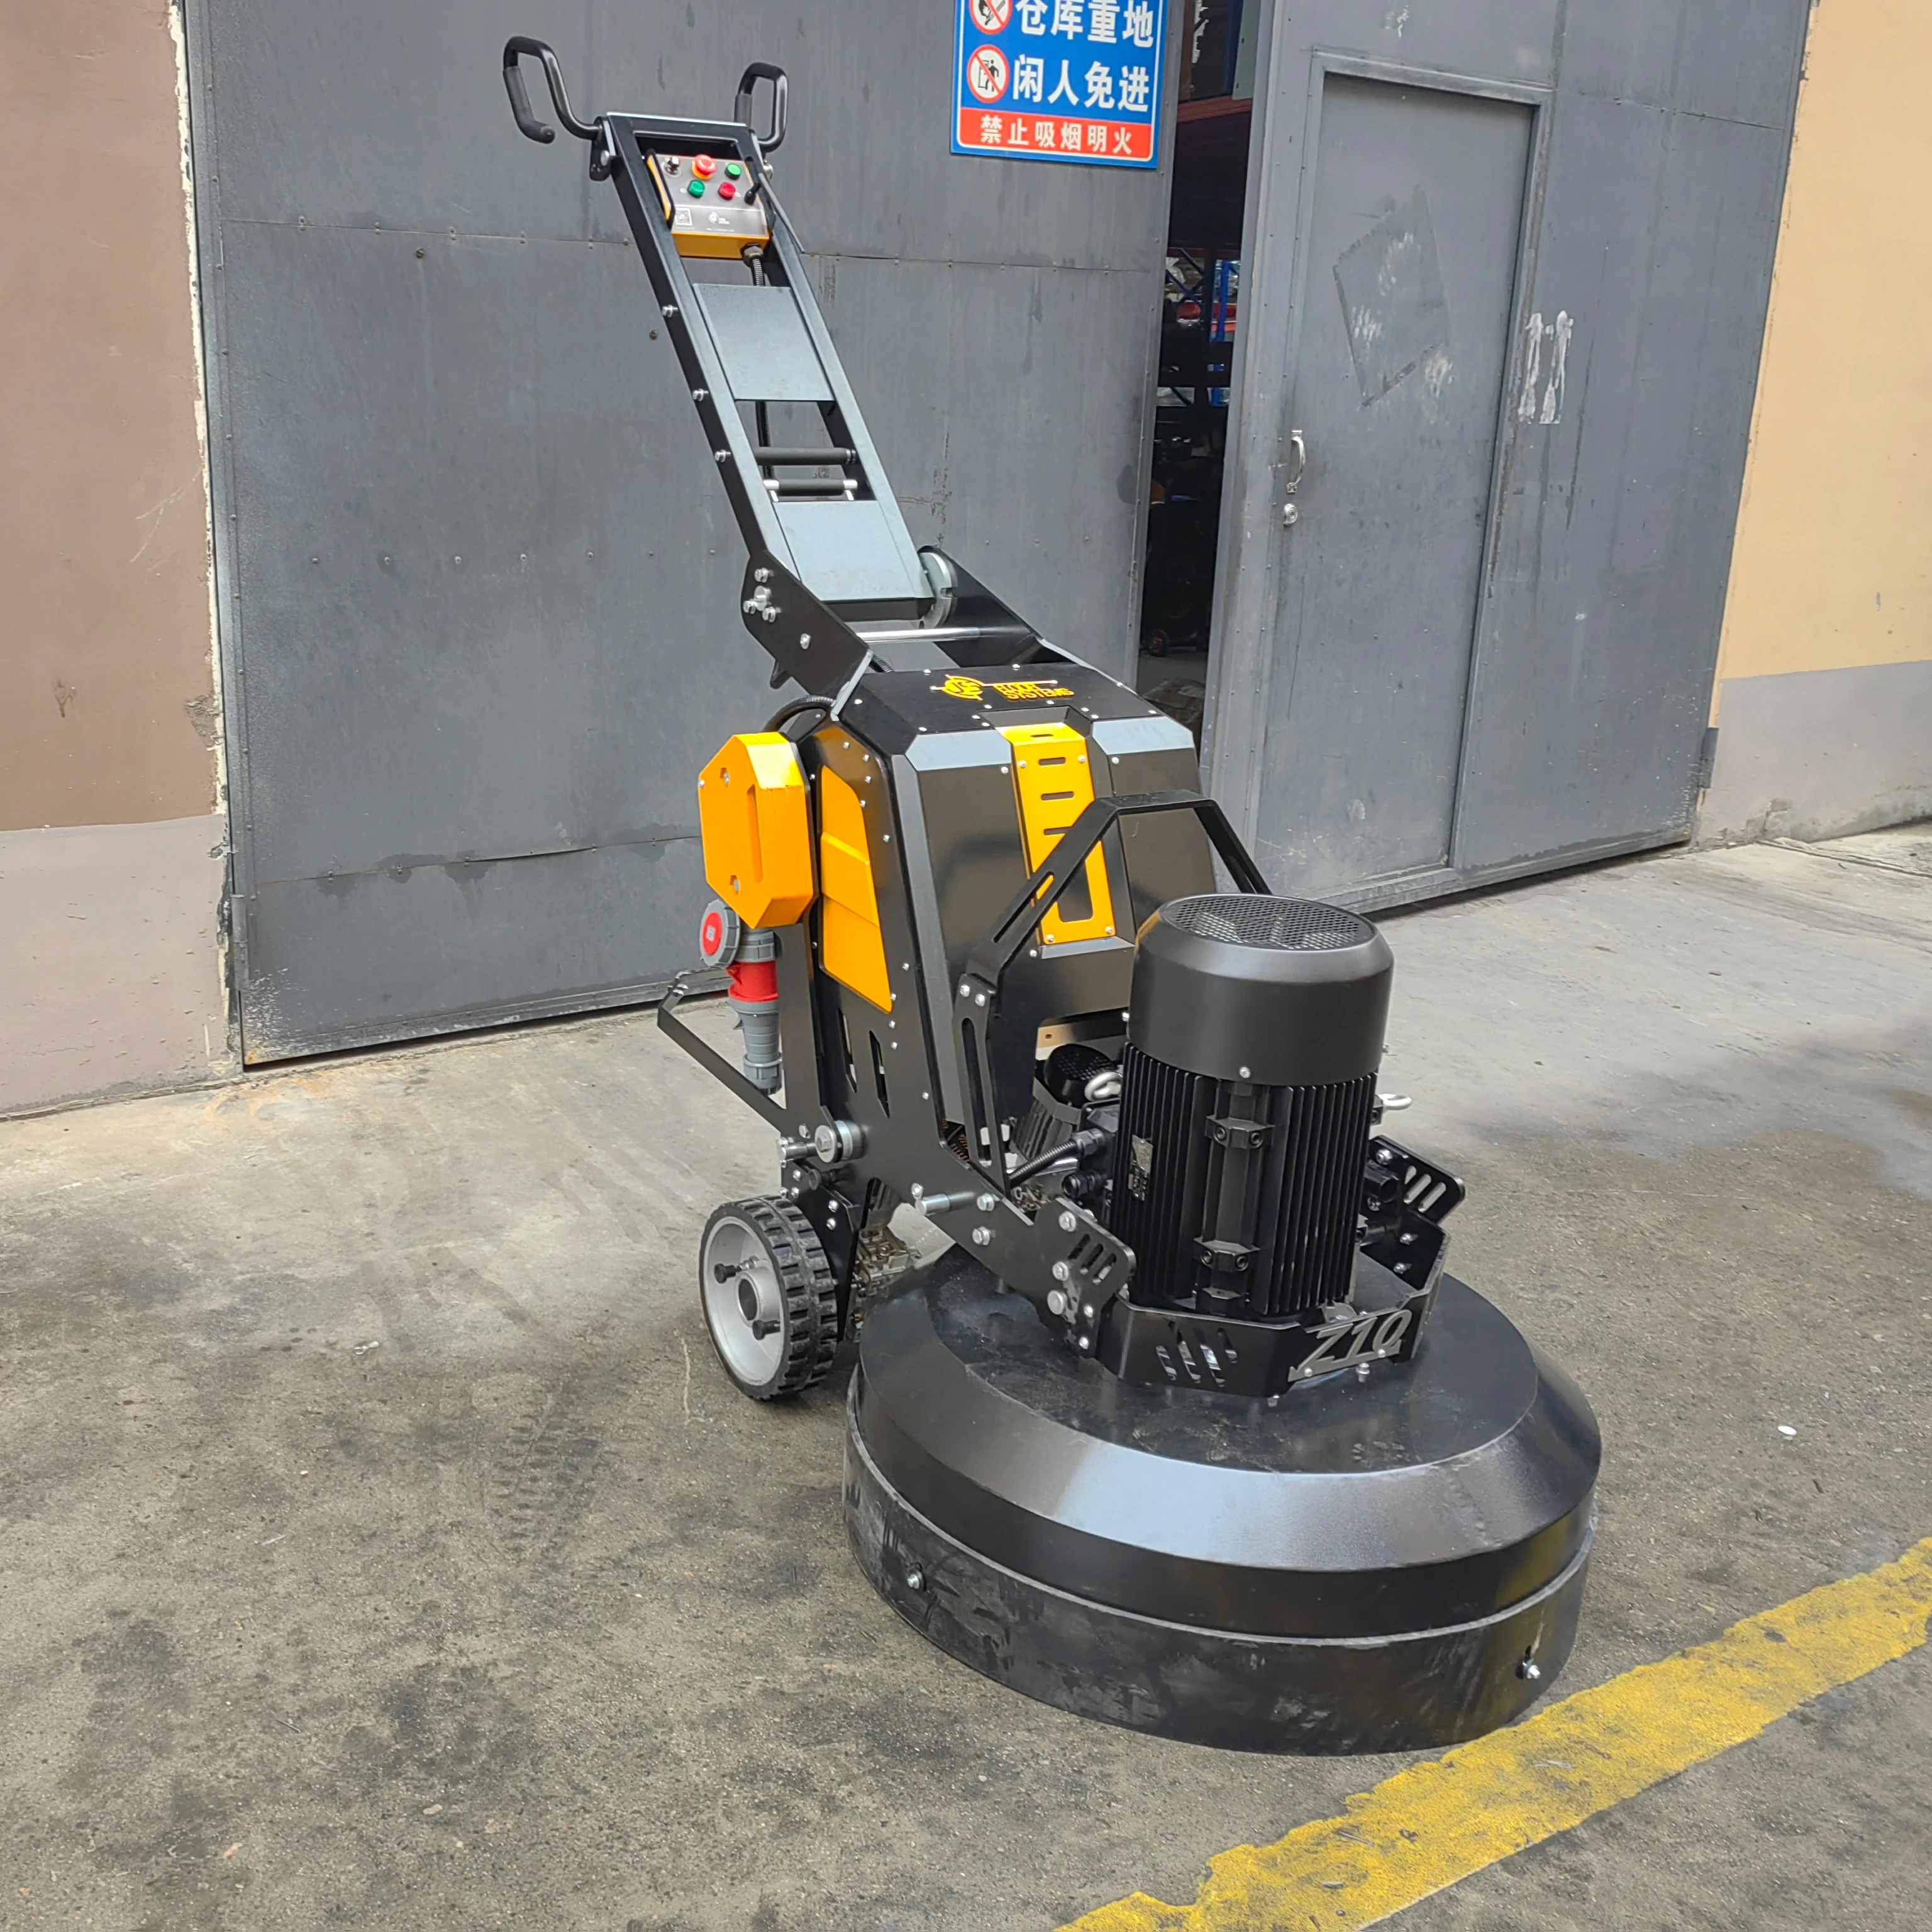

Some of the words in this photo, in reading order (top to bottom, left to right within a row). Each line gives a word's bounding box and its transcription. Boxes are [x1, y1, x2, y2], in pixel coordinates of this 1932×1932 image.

[1015, 0, 1154, 47] 仓库重地
[1013, 54, 1150, 112] 闲人免进
[980, 114, 1133, 155] 禁止吸烟明火
[1004, 688, 1074, 700] SYSTEMS
[1289, 1309, 1413, 1382] Z10
